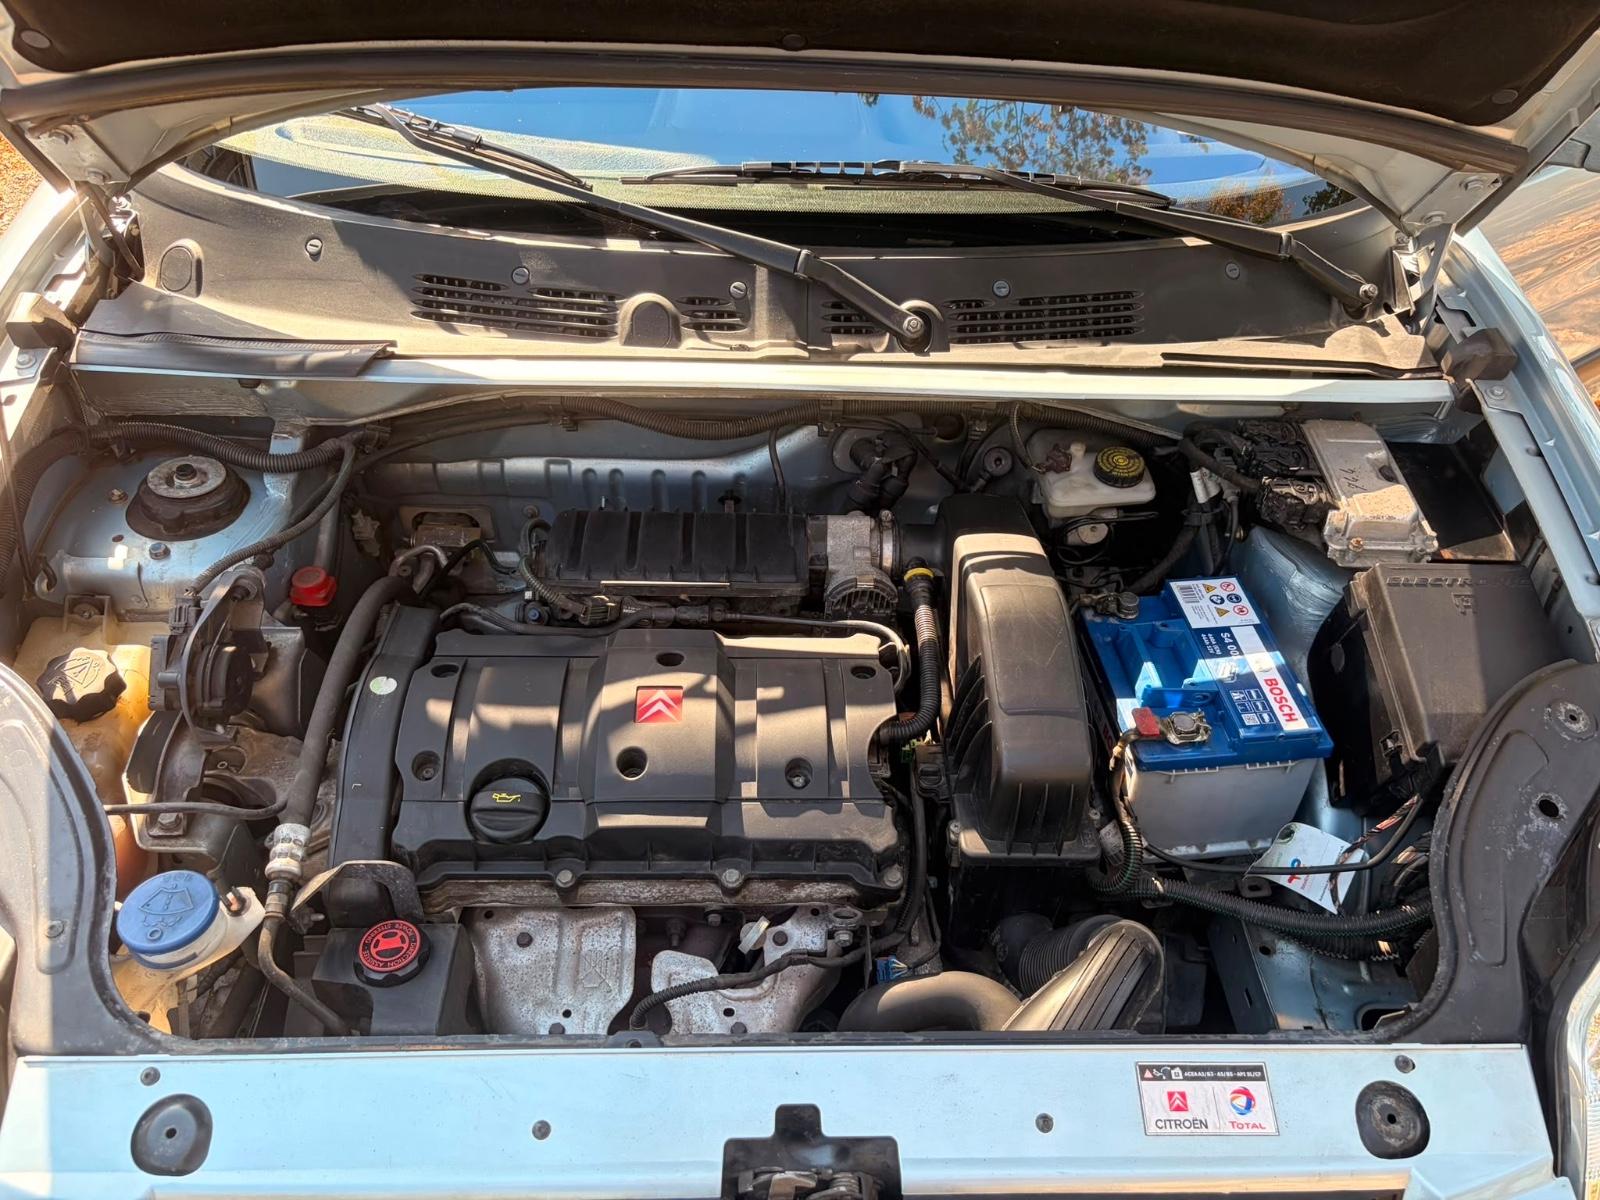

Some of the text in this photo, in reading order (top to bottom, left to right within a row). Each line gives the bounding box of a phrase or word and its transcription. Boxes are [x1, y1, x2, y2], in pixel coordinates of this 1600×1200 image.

[1220, 632, 1234, 644] S4
[1263, 677, 1299, 723] BOSCH
[388, 943, 416, 967] DIRECTION
[1155, 1117, 1208, 1130] CITROËN
[1229, 1121, 1266, 1130] TOTAL
